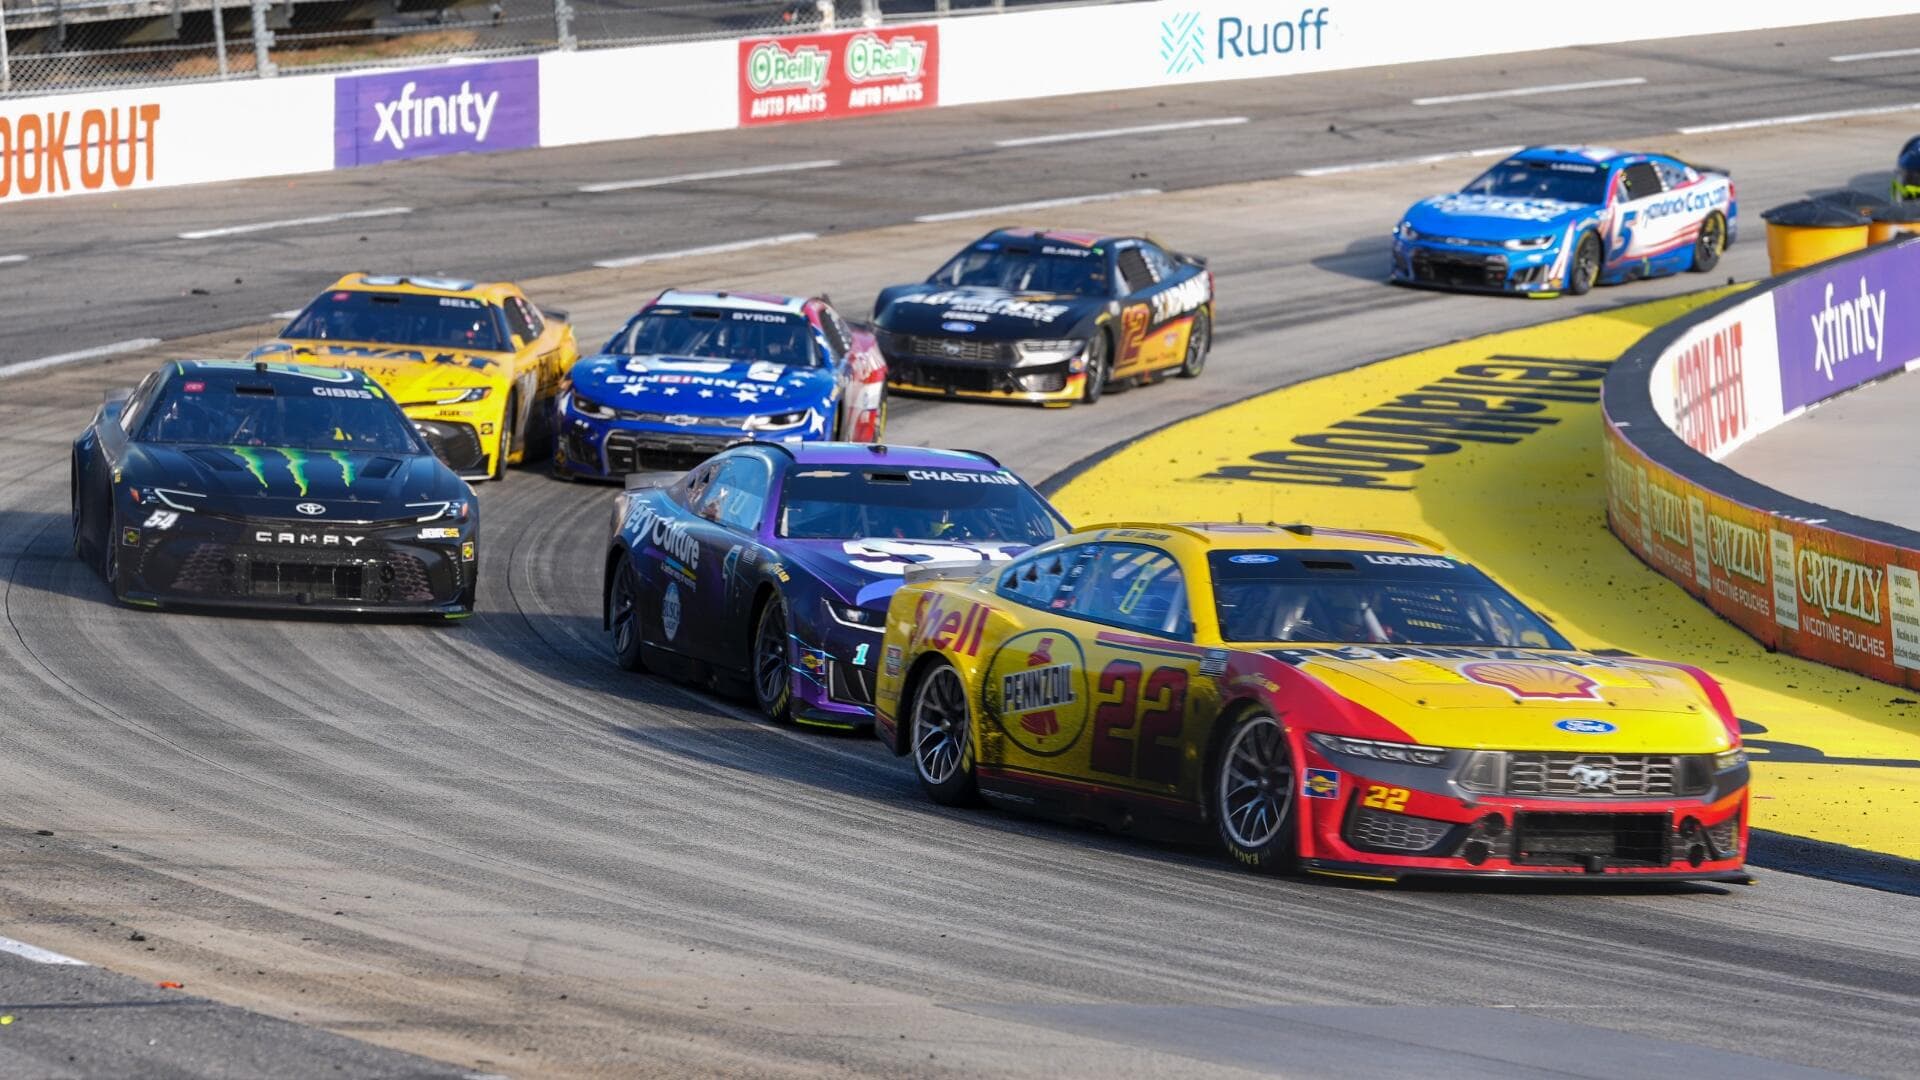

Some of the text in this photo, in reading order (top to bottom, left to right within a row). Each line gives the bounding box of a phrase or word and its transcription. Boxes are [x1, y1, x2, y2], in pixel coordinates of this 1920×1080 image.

[1216, 9, 1329, 59] Ruoff
[751, 45, 827, 87] O'Reilly
[850, 39, 919, 77] O'Reilly
[373, 81, 498, 149] xfinity
[751, 92, 827, 118] AUTO PARTS
[849, 82, 922, 107] AUTO PARTS
[81, 104, 160, 189] OUT
[1610, 210, 1638, 261] 5
[439, 298, 481, 309] BELL
[731, 311, 787, 324] BYRON
[1811, 275, 1886, 381] xfinity
[312, 386, 373, 400] GIBBS
[605, 374, 786, 396] CINCINNATI
[1714, 320, 1747, 444] OUT
[908, 470, 1019, 485] CHASTAIN
[143, 510, 180, 530] 54
[1362, 554, 1455, 569] LOGANO
[1707, 514, 1767, 584] GRIZZLY
[1797, 548, 1883, 625] GRIZZLY
[910, 590, 991, 657] Shell
[1802, 615, 1886, 658] NICOTINE POUCHES
[852, 643, 870, 666] 1
[1002, 663, 1076, 714] PENNZOIL
[1090, 659, 1189, 785] 22
[1363, 785, 1411, 812] 22
